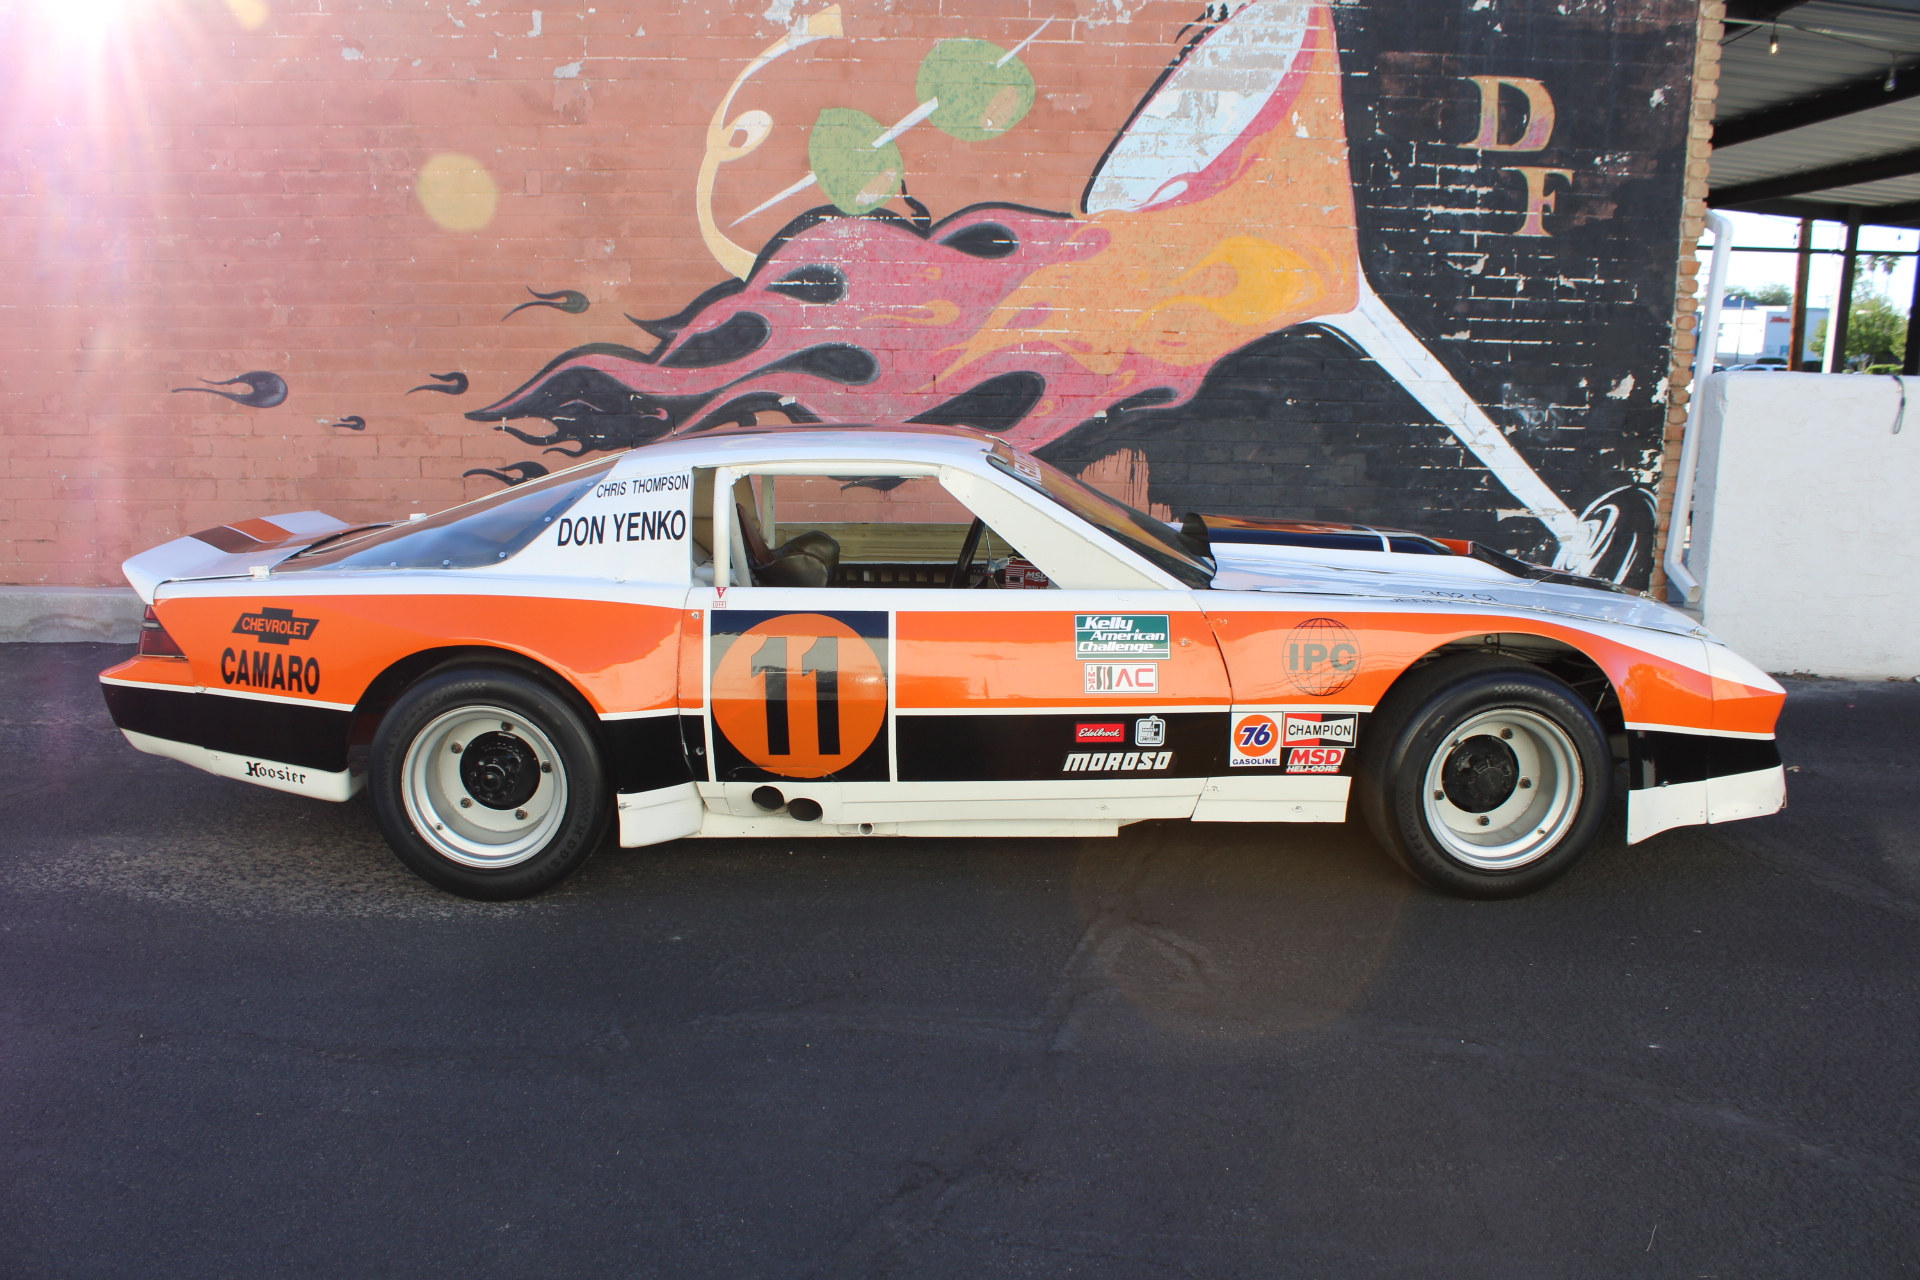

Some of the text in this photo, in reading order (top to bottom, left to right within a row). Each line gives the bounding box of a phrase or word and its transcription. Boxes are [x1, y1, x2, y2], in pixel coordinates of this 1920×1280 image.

[1457, 75, 1556, 152] D
[1512, 166, 1574, 237] F
[596, 474, 690, 498] CHRIS THOMPSON
[557, 509, 687, 547] DON YENKO
[241, 617, 310, 636] CHEVROLET
[1084, 616, 1134, 632] Kelly
[1090, 628, 1165, 641] American
[1078, 641, 1154, 654] Challenge
[1289, 643, 1357, 672] IPC
[221, 647, 320, 695] CAMARO
[751, 636, 841, 756] 11
[1078, 728, 1120, 738] Edelbrock
[1239, 723, 1272, 747] 76
[1288, 724, 1351, 736] CHAMPION
[1062, 751, 1173, 772] MOROSO
[1290, 749, 1342, 765] MSD
[245, 761, 307, 784] Hoosier
[1286, 765, 1339, 773] HELI-CORE
